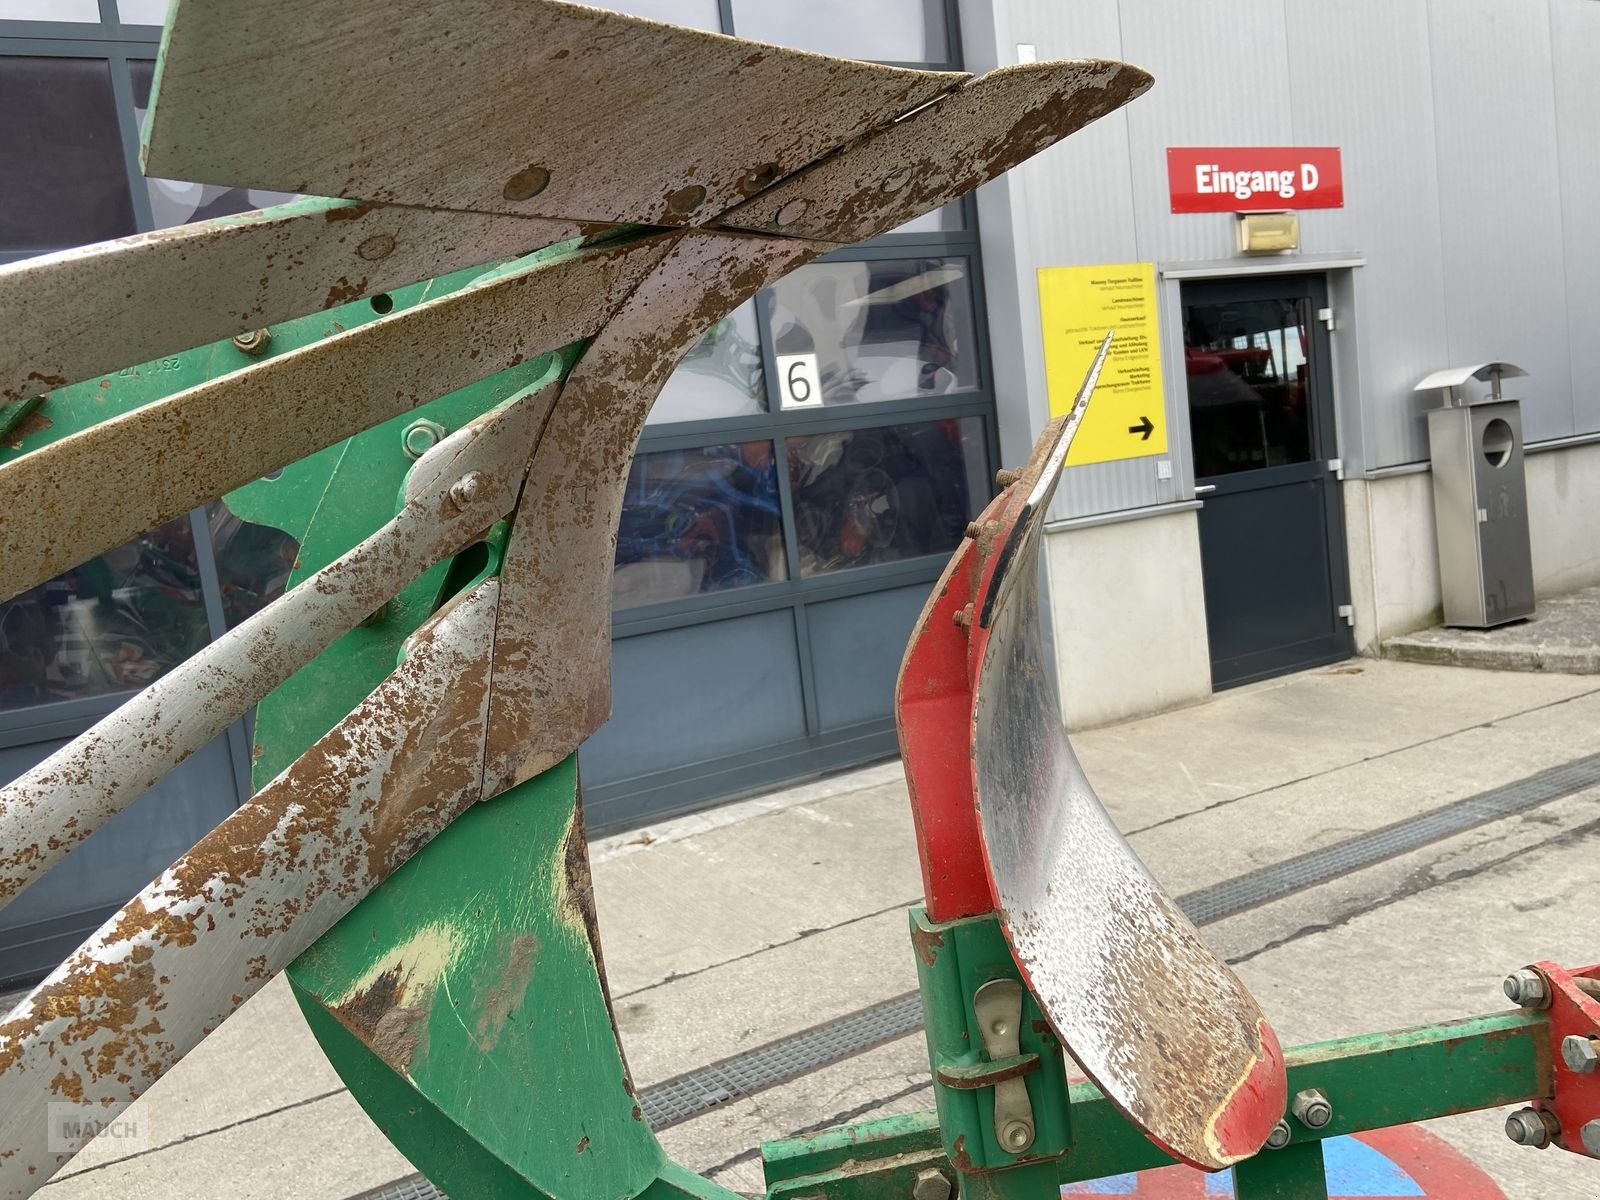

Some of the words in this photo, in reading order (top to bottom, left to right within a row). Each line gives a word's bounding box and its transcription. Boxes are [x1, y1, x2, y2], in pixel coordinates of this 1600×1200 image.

[1195, 164, 1295, 200] Eingang
[1300, 163, 1319, 191] D
[788, 361, 811, 402] 6
